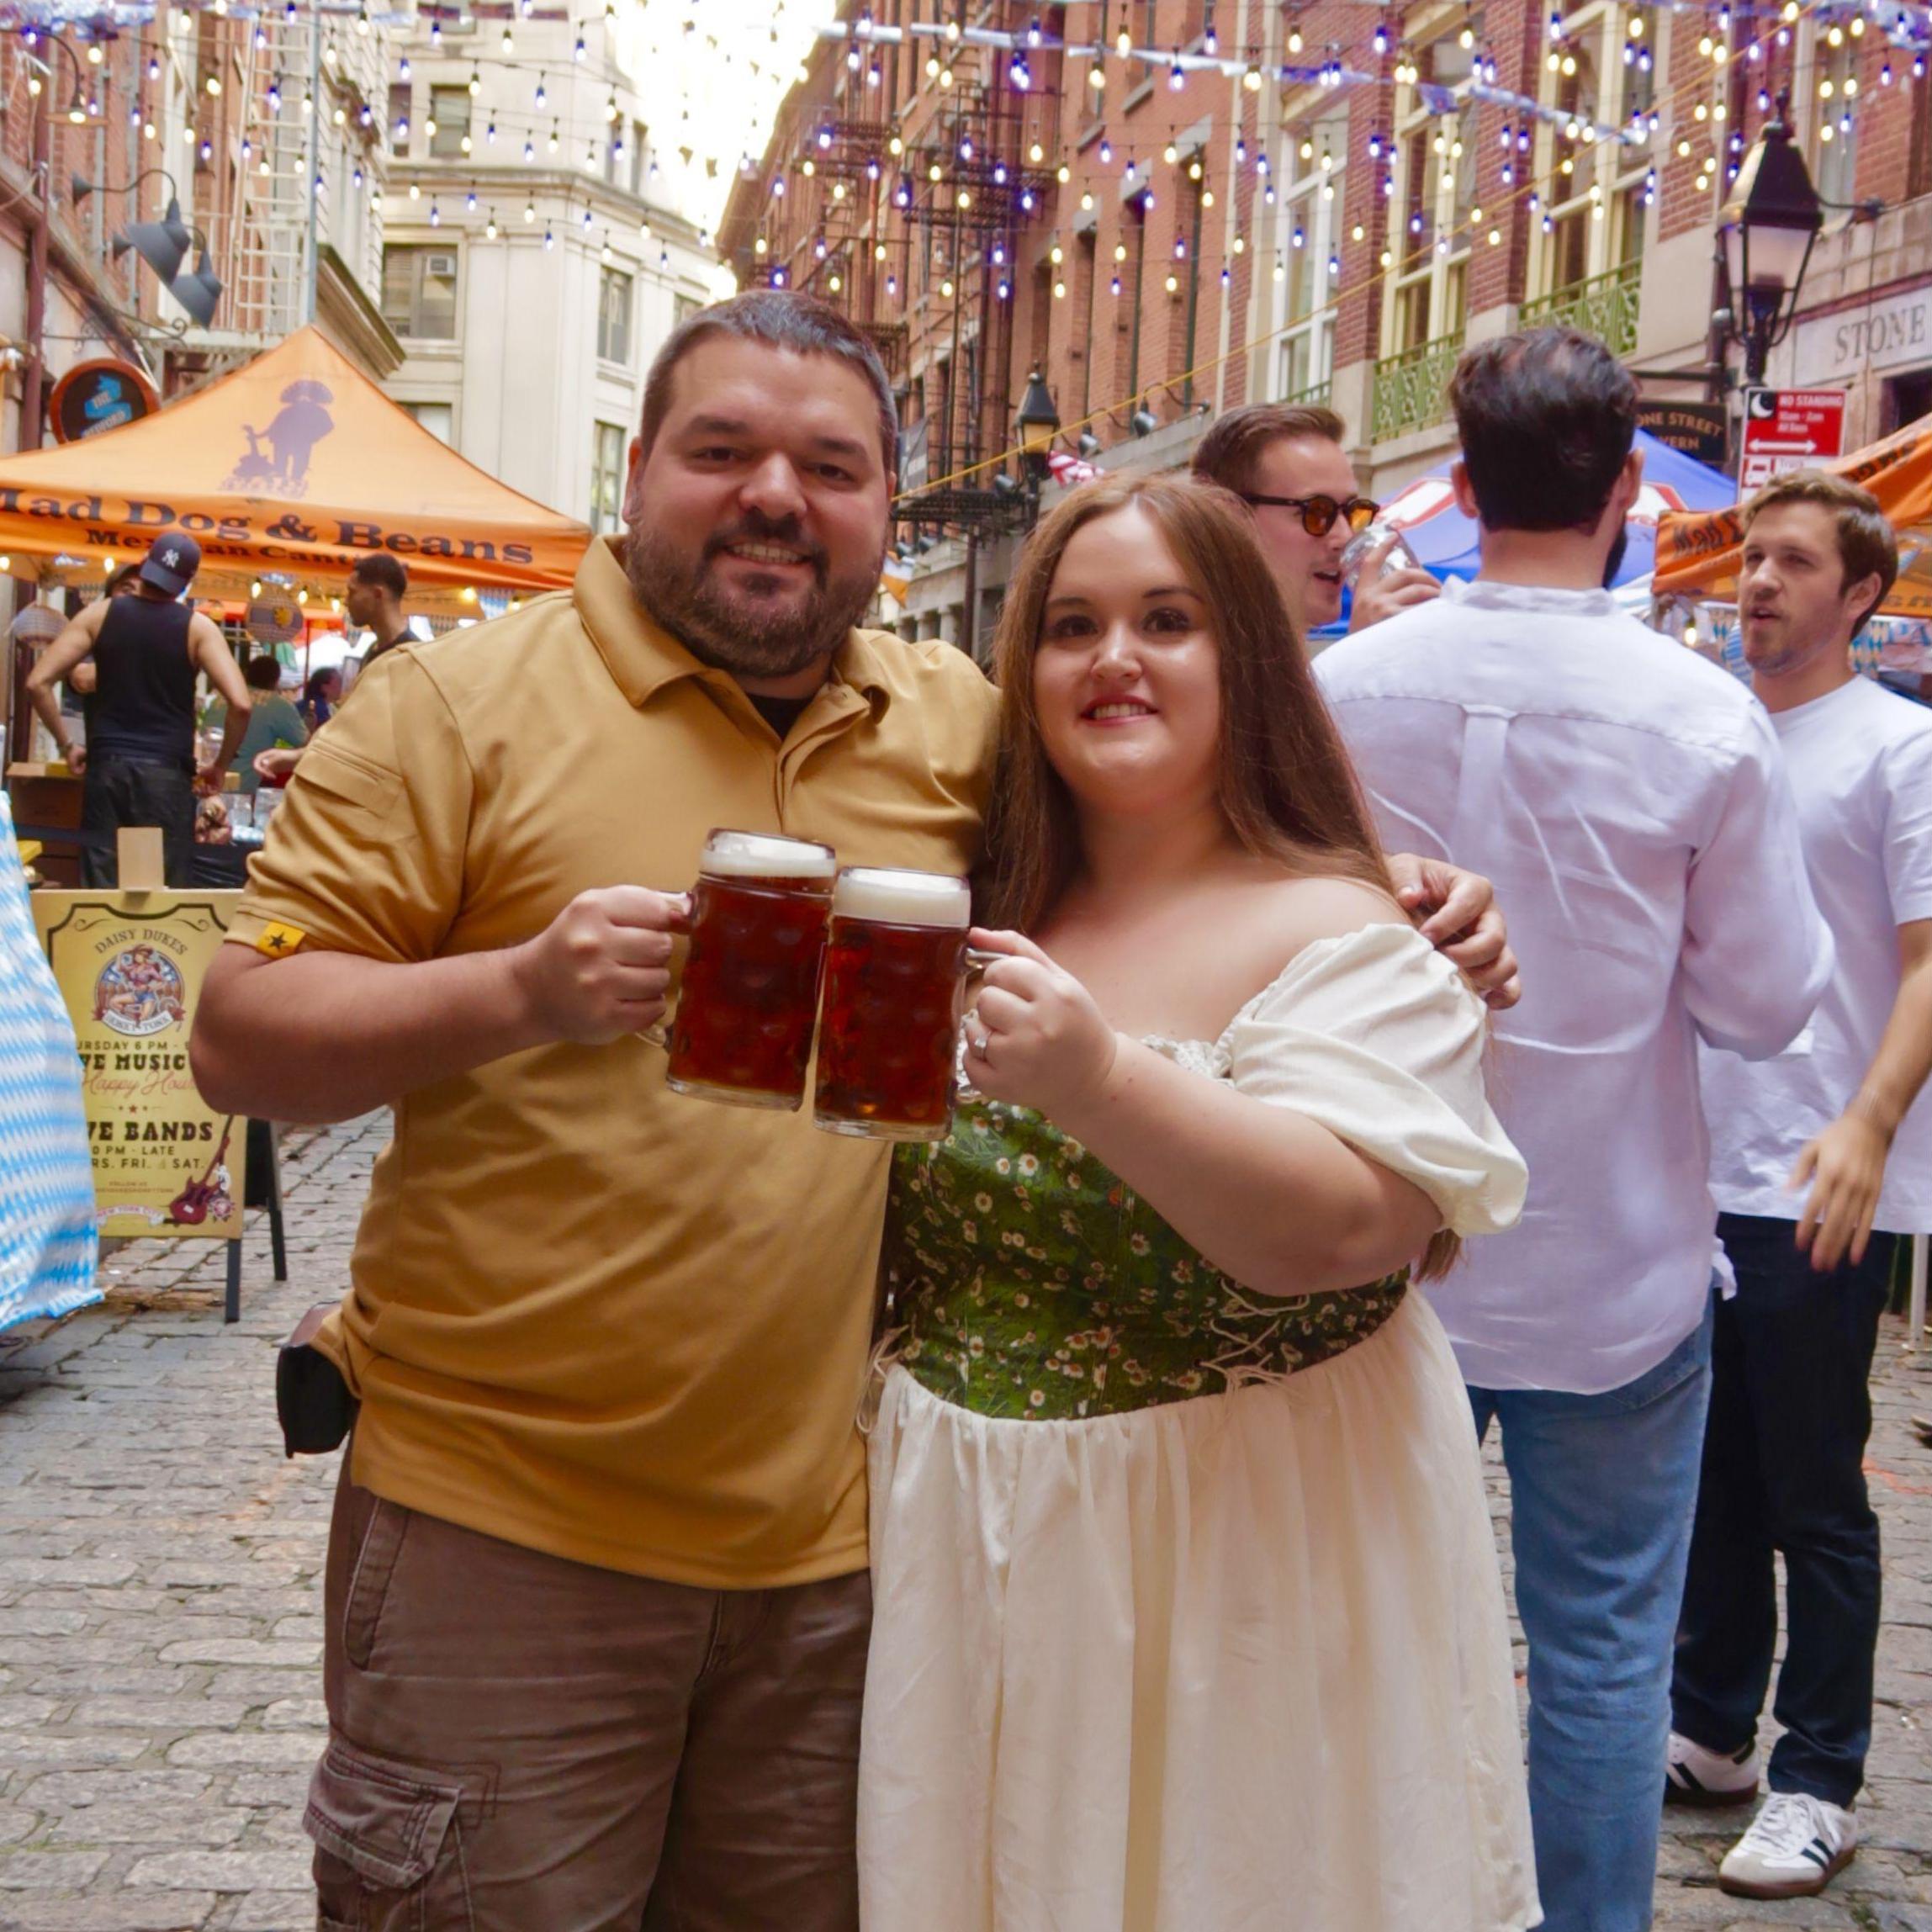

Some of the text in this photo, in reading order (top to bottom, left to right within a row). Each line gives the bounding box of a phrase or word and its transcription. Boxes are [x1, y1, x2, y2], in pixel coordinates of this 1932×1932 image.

[1834, 304, 1926, 365] STONE
[1796, 395, 1843, 408] STANDING
[1668, 410, 1724, 437] STREET
[124, 500, 251, 541] Dog
[265, 514, 317, 543] &
[334, 519, 533, 564] Beans
[94, 928, 188, 955] DAISY DUKES
[147, 1040, 167, 1050] PM
[114, 1053, 186, 1071] MUSIC
[124, 1121, 213, 1141] BANDS
[105, 1145, 125, 1155] PM
[141, 1145, 175, 1155] LATE
